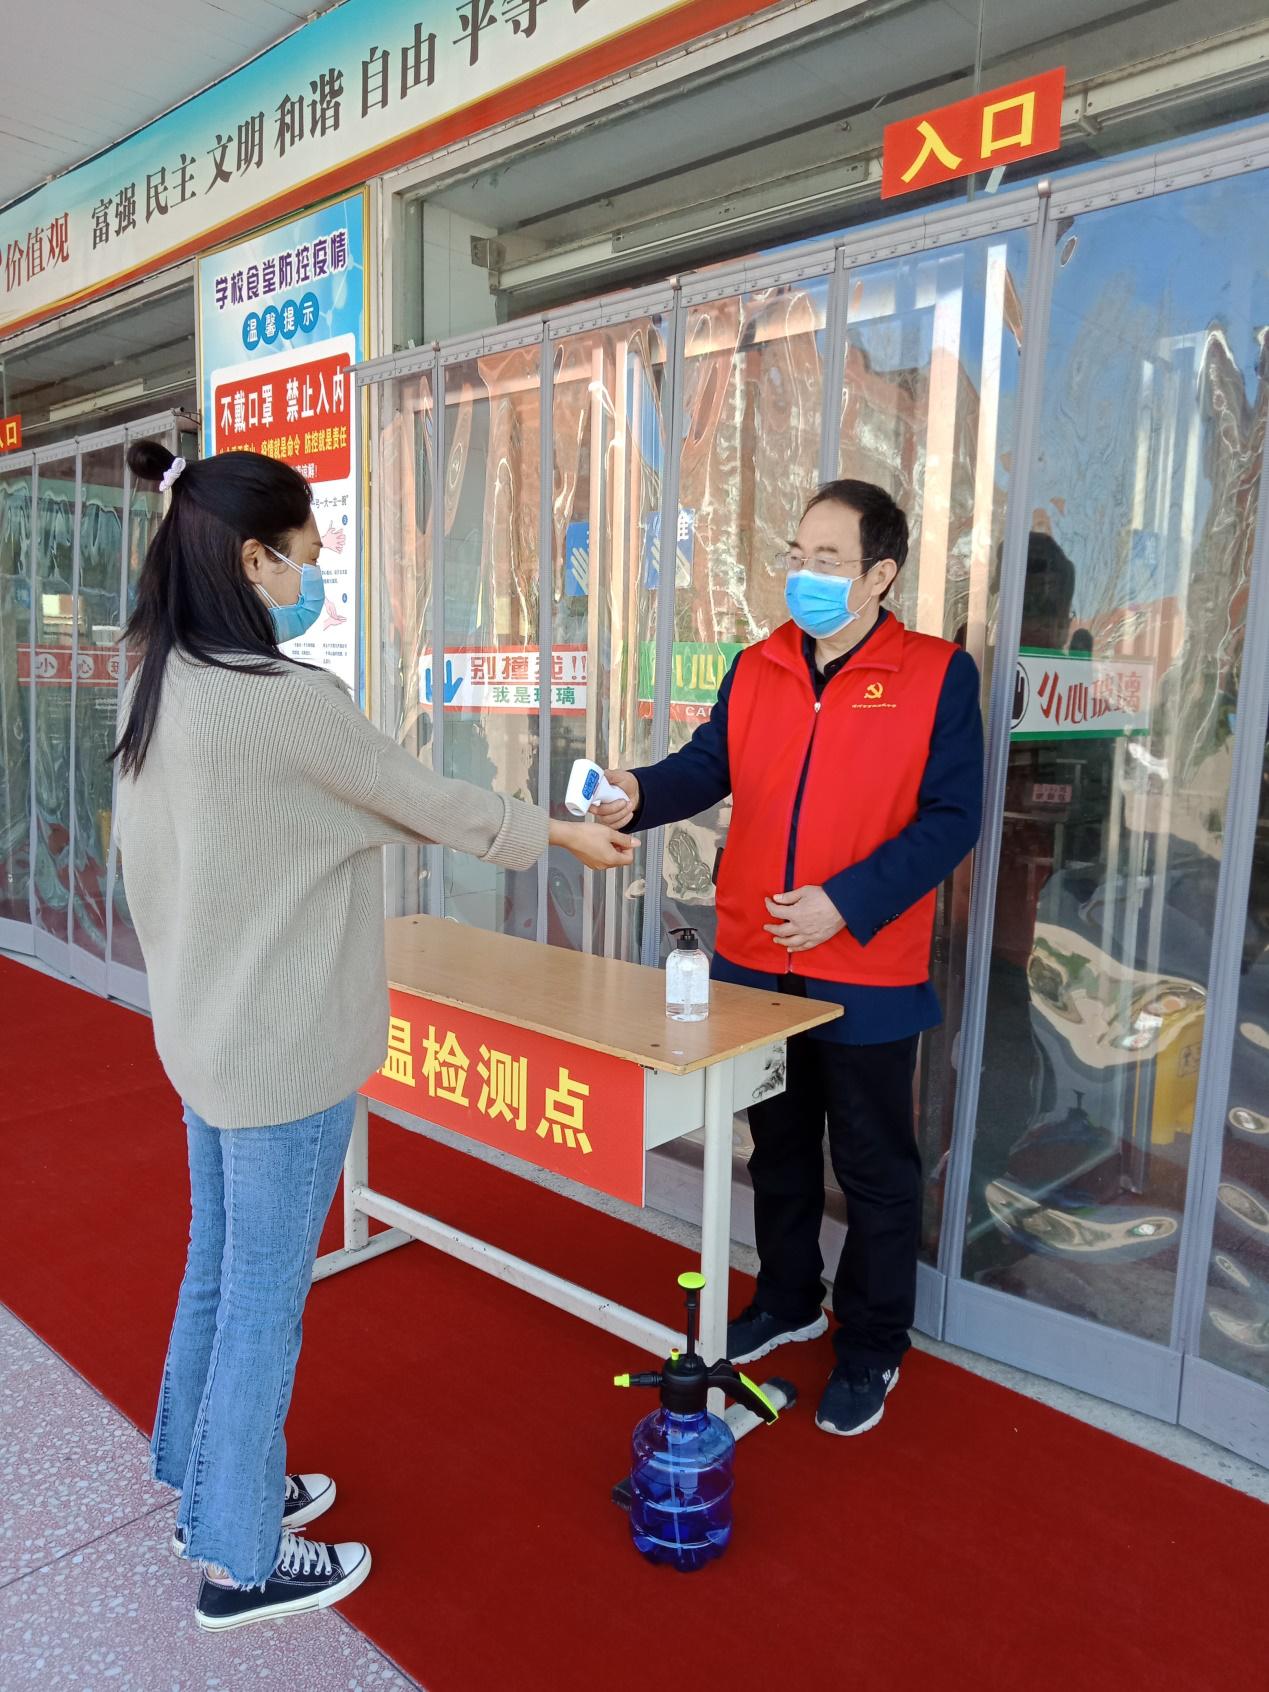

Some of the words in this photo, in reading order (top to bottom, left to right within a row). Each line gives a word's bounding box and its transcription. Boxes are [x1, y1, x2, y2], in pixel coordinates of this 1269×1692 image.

[0, 212, 69, 293] 价值观
[91, 182, 136, 250] 富强
[145, 153, 197, 224] 民主
[205, 111, 265, 195] 文明
[274, 68, 344, 158] 和谐
[361, 22, 437, 119] 自由
[900, 91, 1035, 184] 入口
[215, 231, 348, 310] 学校食堂防控疫情
[246, 300, 314, 344] 温馨提示
[220, 383, 274, 436] 不戴口罩
[286, 366, 344, 422] 禁止入内
[304, 426, 347, 454] 防控就是责任
[685, 706, 712, 717] CA
[1037, 671, 1142, 726] 小心玻璃
